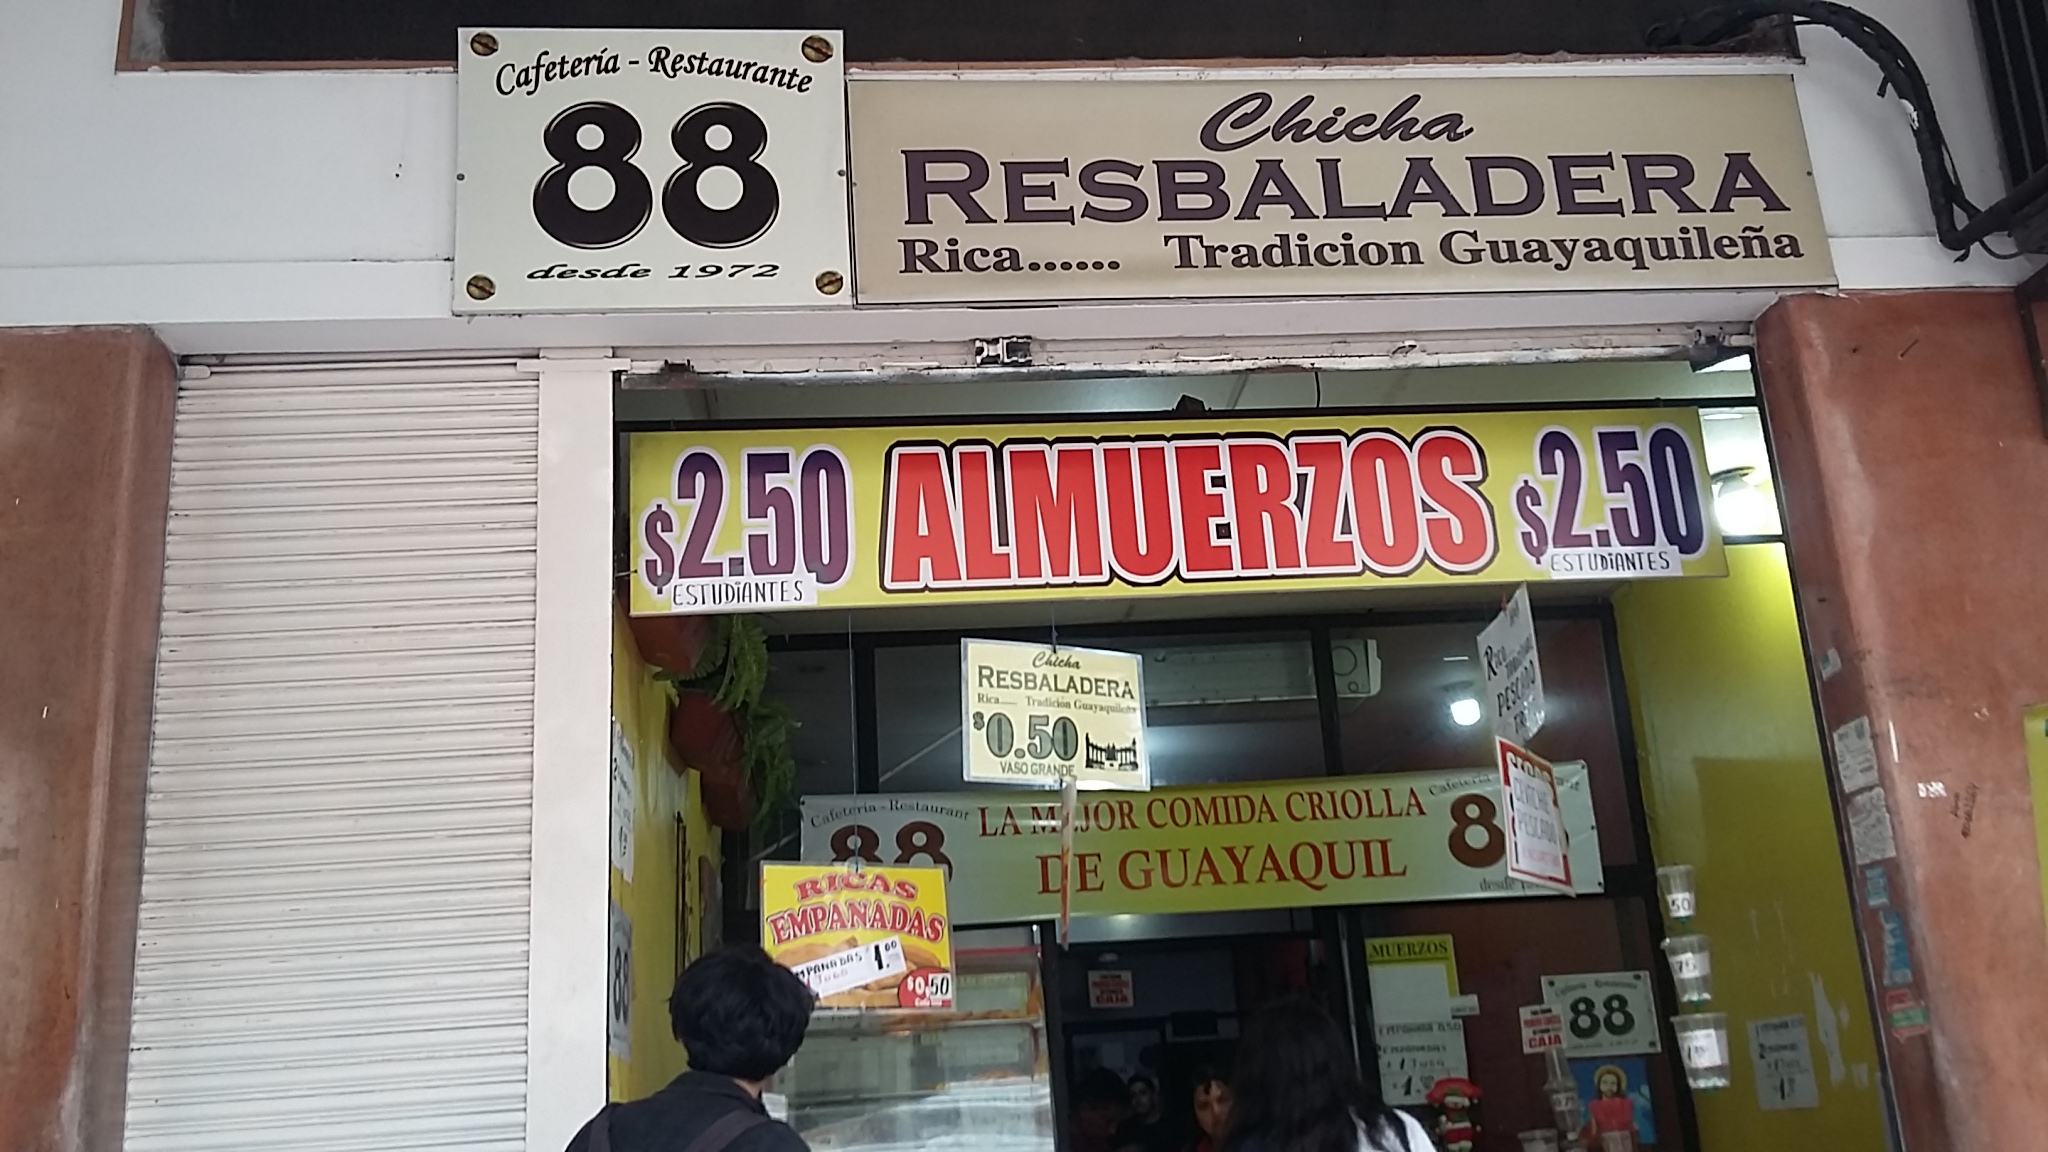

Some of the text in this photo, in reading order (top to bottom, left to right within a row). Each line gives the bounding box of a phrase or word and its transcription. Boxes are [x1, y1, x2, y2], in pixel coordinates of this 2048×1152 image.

[495, 47, 620, 96] Cafetería
[648, 46, 813, 93] Restaurante
[1199, 91, 1474, 152] Chicha
[532, 101, 779, 249] 88
[901, 150, 1793, 226] RESBALADERA
[527, 263, 780, 279] desde 1972
[1163, 232, 1424, 270] Tradicion
[1439, 226, 1804, 272] Guayaquileña
[884, 433, 1494, 588] ALMUERZOS
[977, 665, 1134, 699] RESBALADERA
[1032, 651, 1081, 670] Chicha
[1000, 761, 1075, 778] VASO GRANDE
[889, 800, 970, 821] Restaurant
[979, 787, 1426, 837] LA MJOR COMIDA CRIOLLA
[794, 872, 919, 901] RICAS
[1036, 839, 1406, 895] DE GUAYAQUIL
[767, 899, 946, 946] EMPANADAS
[614, 945, 631, 1025] 88
[1569, 994, 1635, 1039] 88
[1528, 1034, 1562, 1048] CAJA
